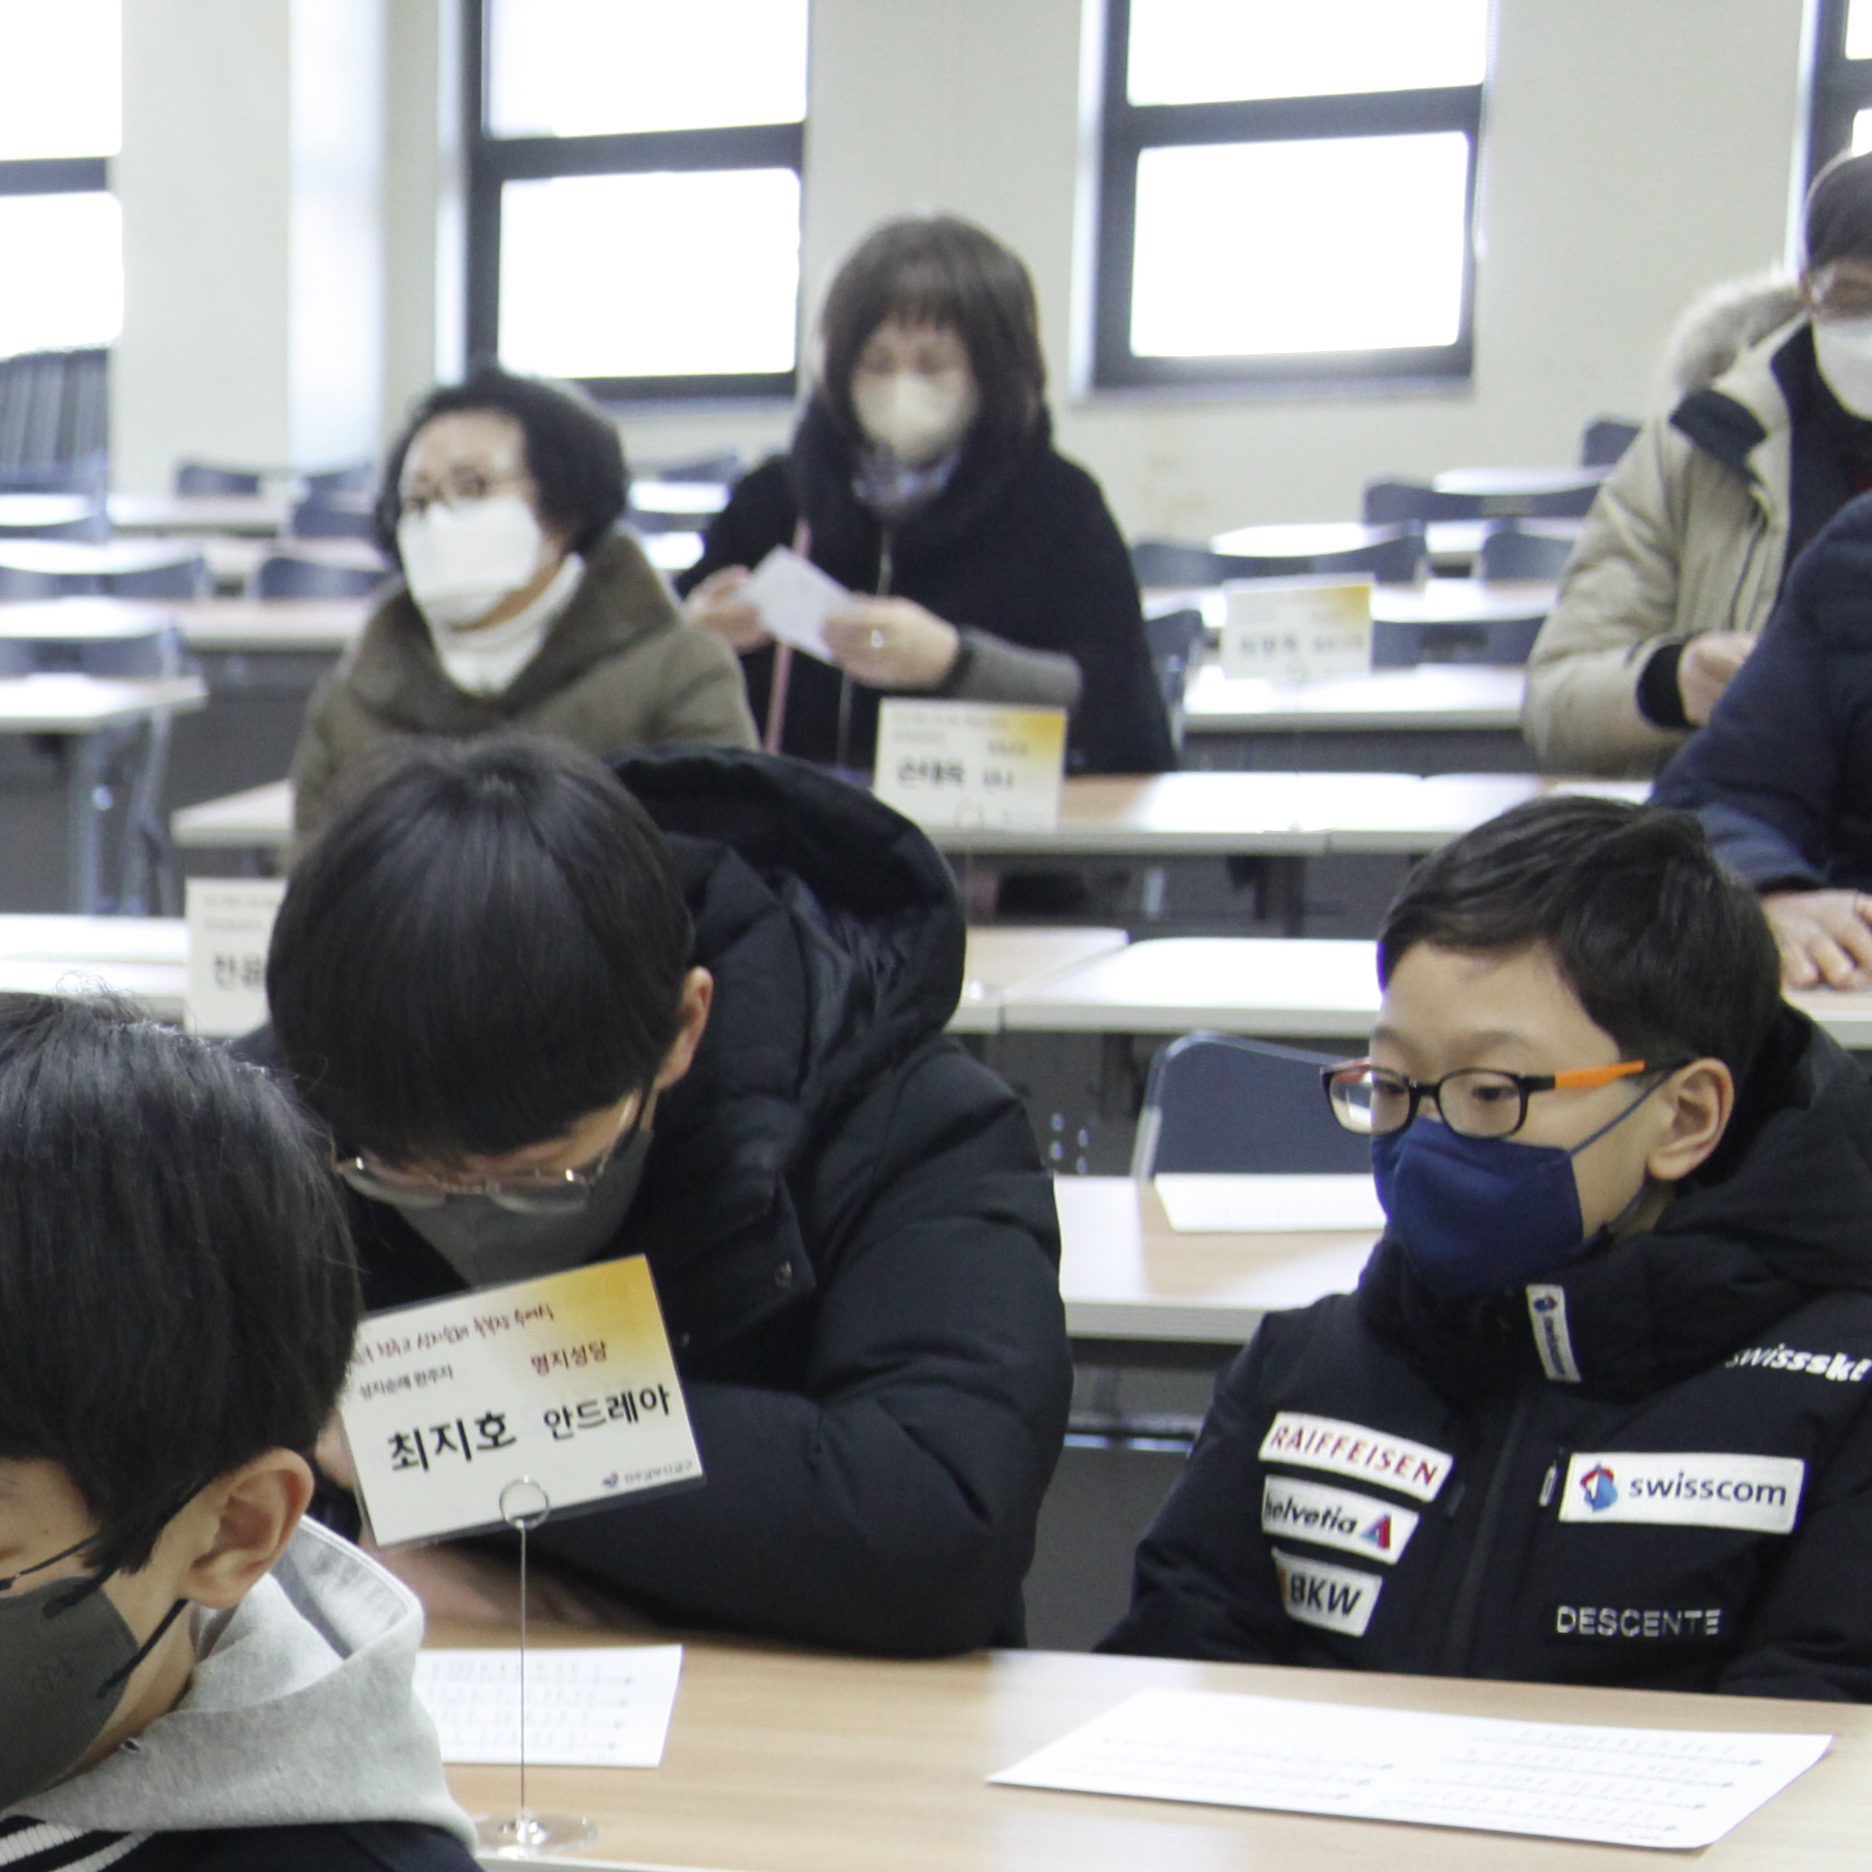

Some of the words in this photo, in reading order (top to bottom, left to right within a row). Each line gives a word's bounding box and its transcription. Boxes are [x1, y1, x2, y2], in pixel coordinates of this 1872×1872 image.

[531, 1340, 608, 1376] 명지성당
[388, 1410, 516, 1473] 최지호
[543, 1383, 671, 1442] 안드레아
[1270, 1426, 1437, 1488] RAIFFEISEN
[1629, 1469, 1787, 1508] swisscom
[1265, 1494, 1358, 1534] helvetia
[1291, 1574, 1362, 1617] BKW
[1557, 1606, 1724, 1637] DESCENTE
